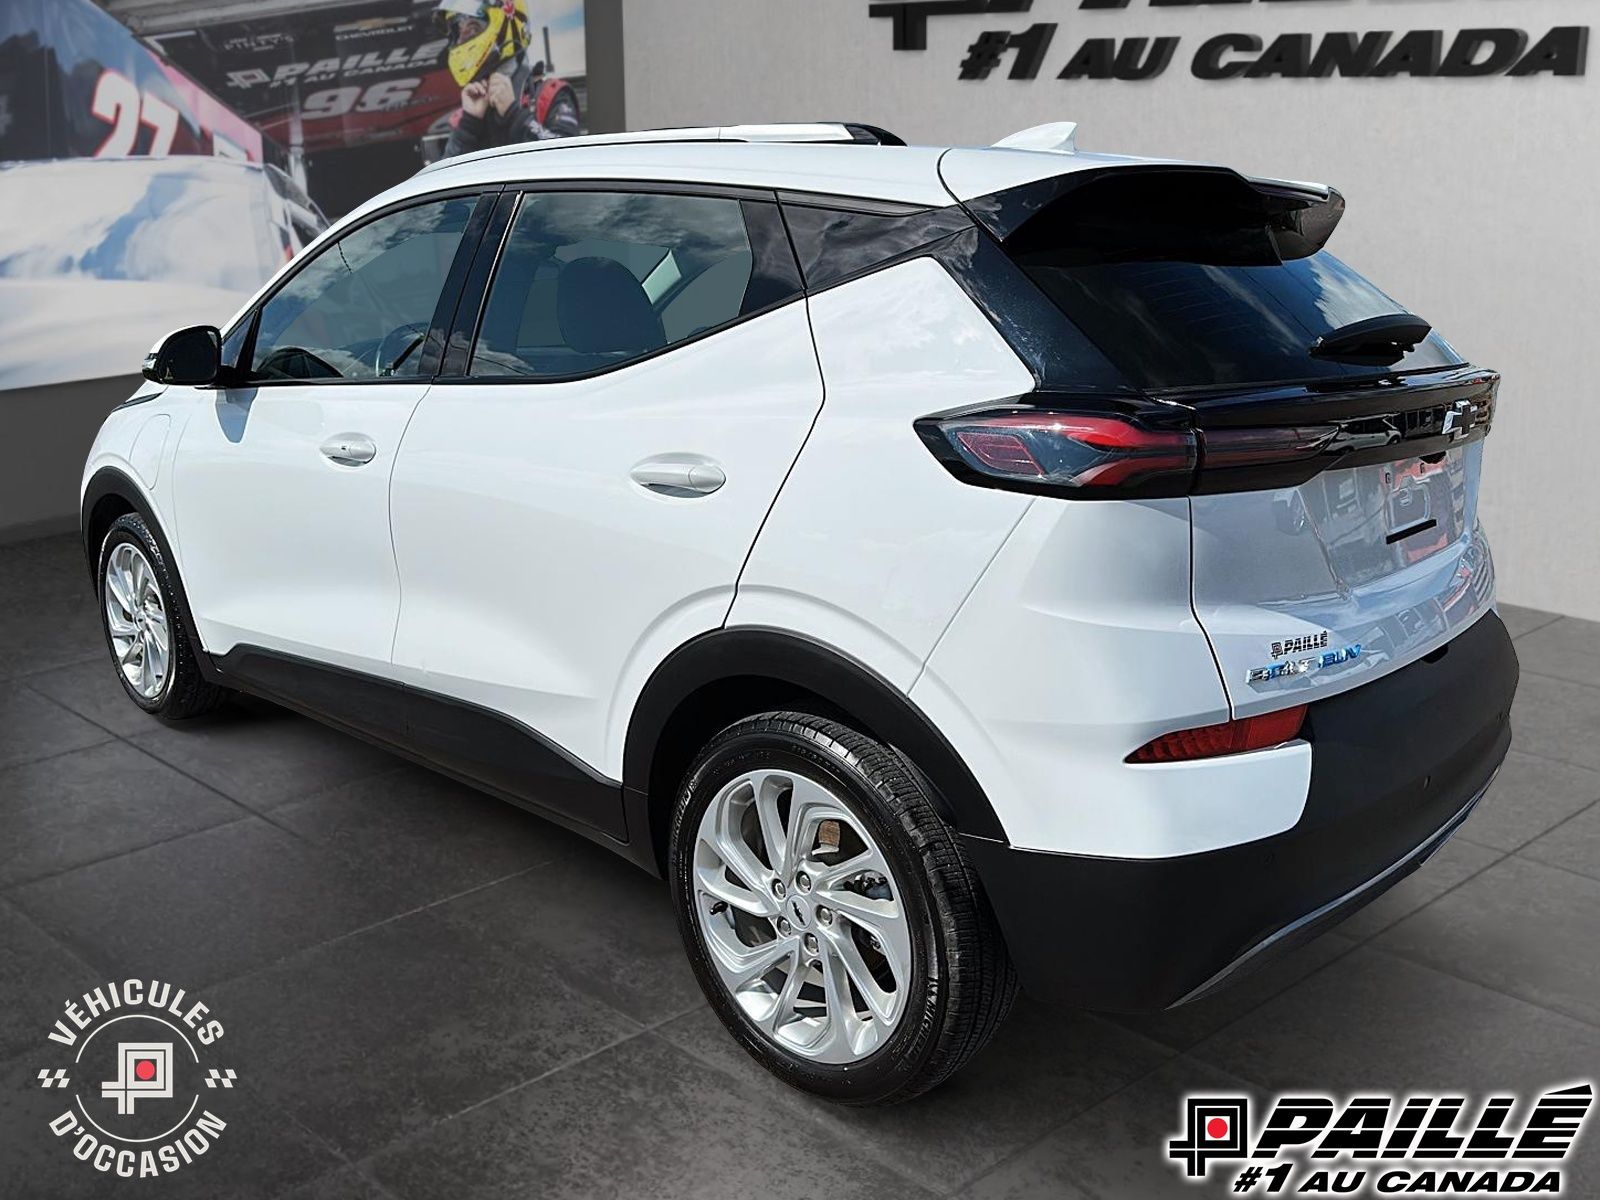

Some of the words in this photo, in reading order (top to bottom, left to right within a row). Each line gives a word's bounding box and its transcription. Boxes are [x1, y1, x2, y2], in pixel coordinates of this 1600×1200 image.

[336, 25, 415, 41] CHEVROLET
[957, 22, 1058, 80] #1
[1057, 36, 1180, 80] AU
[1190, 25, 1590, 80] CANADA
[303, 72, 335, 84] AU
[344, 58, 438, 78] CANADA
[300, 78, 422, 120] 96
